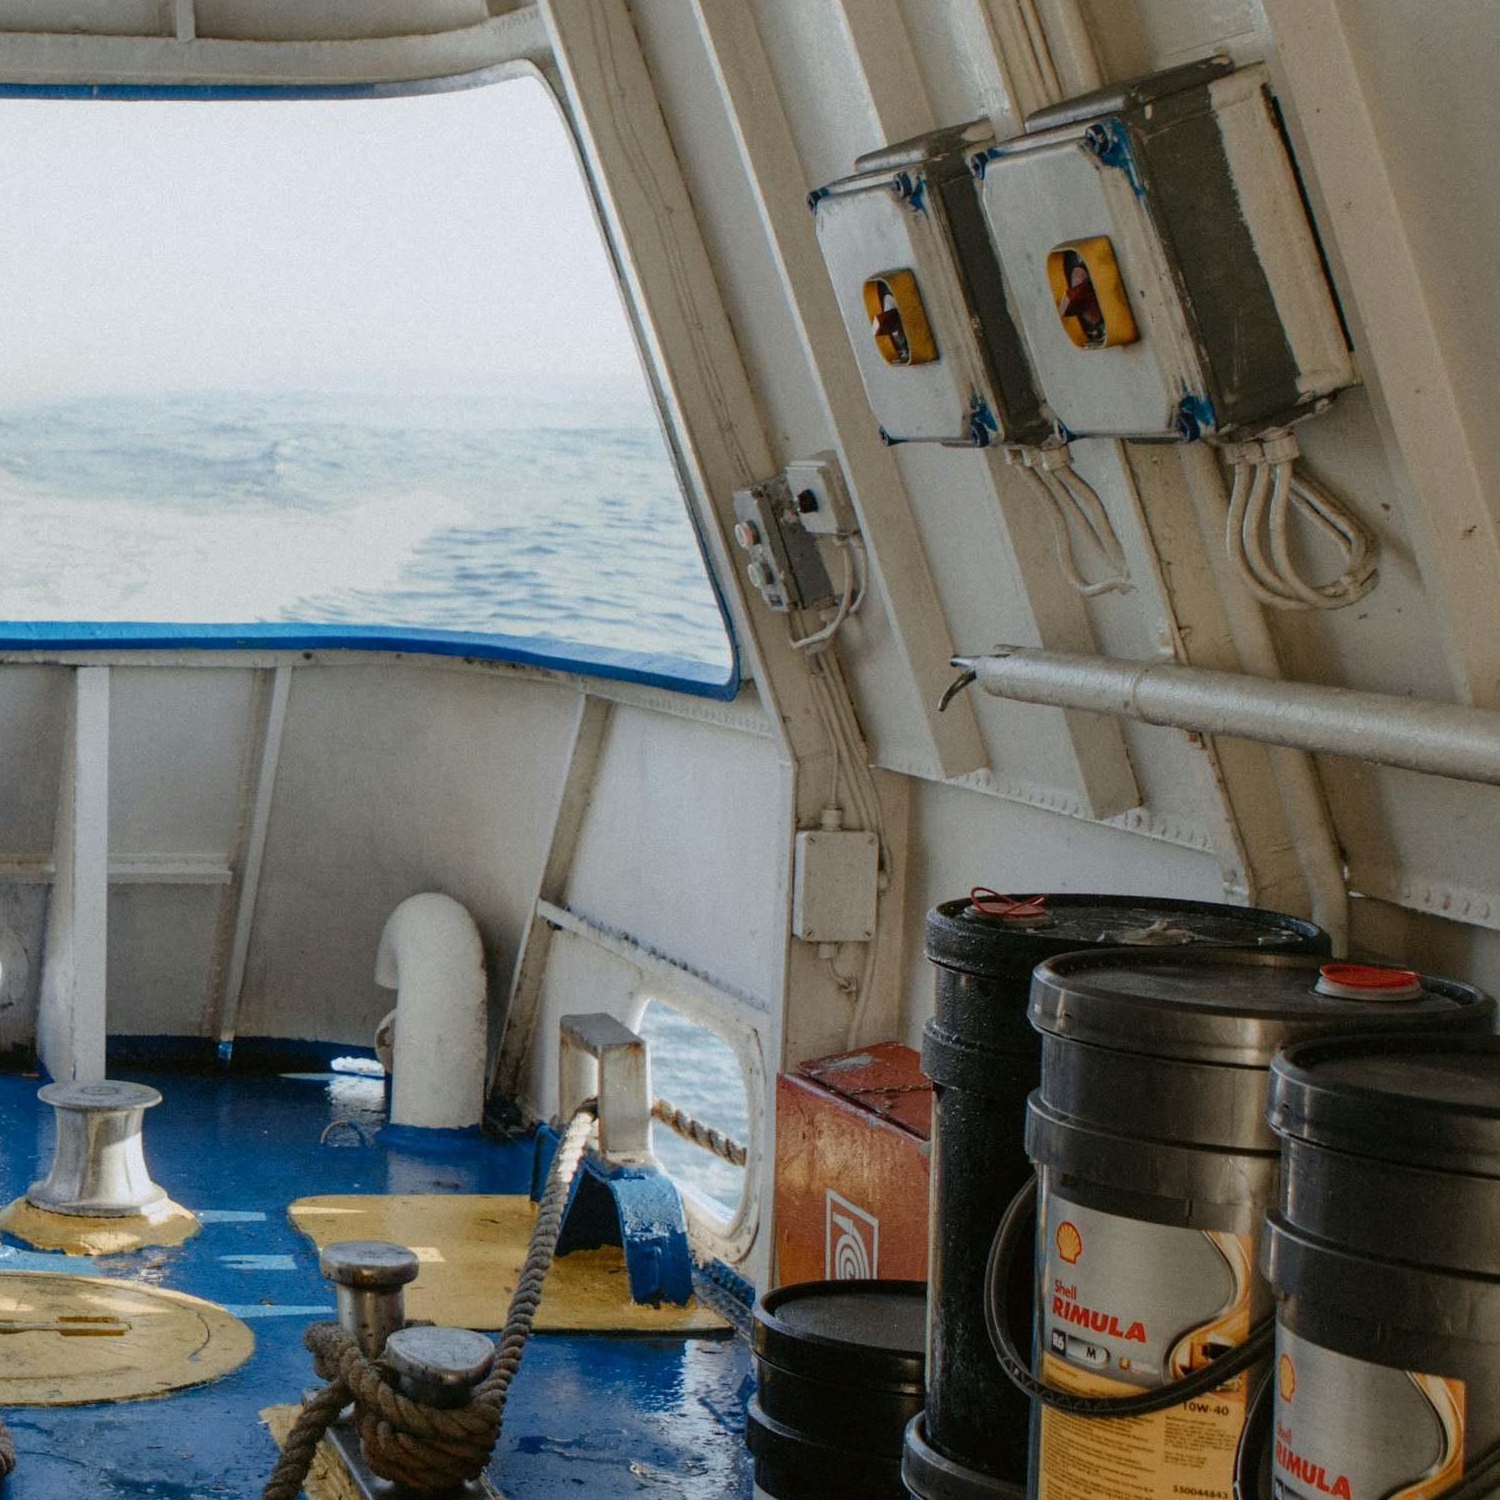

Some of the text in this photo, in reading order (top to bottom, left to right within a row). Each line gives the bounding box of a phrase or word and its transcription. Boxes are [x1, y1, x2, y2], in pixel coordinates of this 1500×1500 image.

[1054, 1279, 1077, 1300] Shell
[1052, 1295, 1147, 1344] RIMULA
[1086, 1346, 1096, 1360] M
[1183, 1400, 1230, 1417] 10W-40
